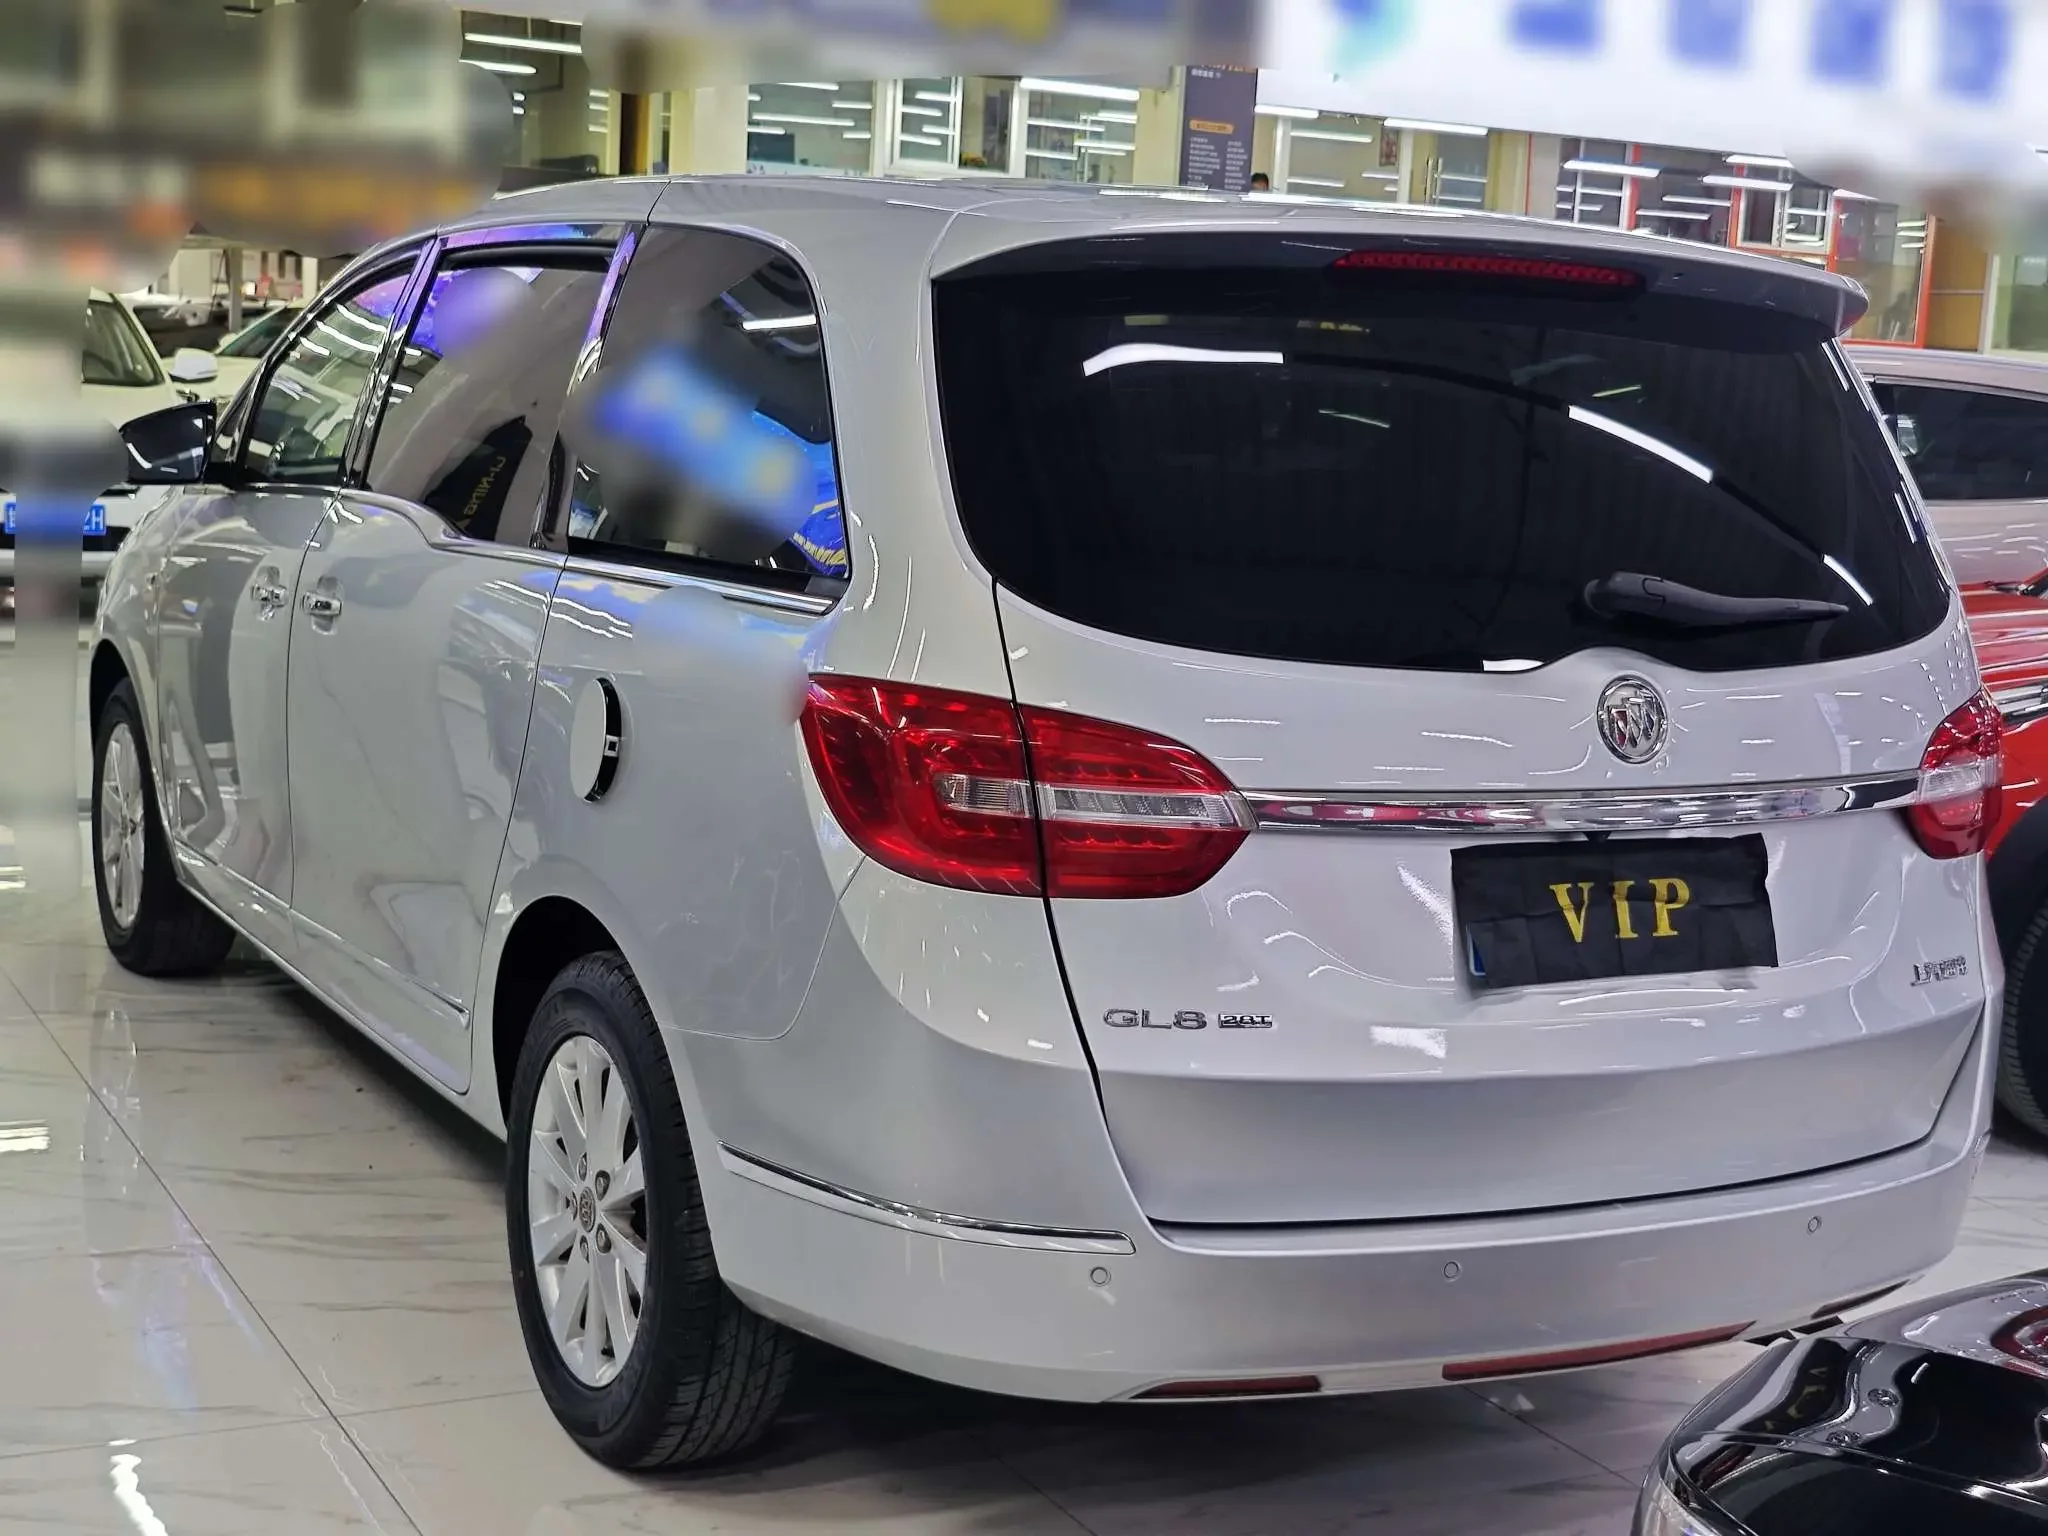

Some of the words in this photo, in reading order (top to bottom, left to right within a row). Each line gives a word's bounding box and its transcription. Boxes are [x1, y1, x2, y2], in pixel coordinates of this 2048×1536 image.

[1550, 878, 1692, 943] VIP
[1103, 1009, 1208, 1030] GL8
[1220, 1014, 1272, 1028] 28T
